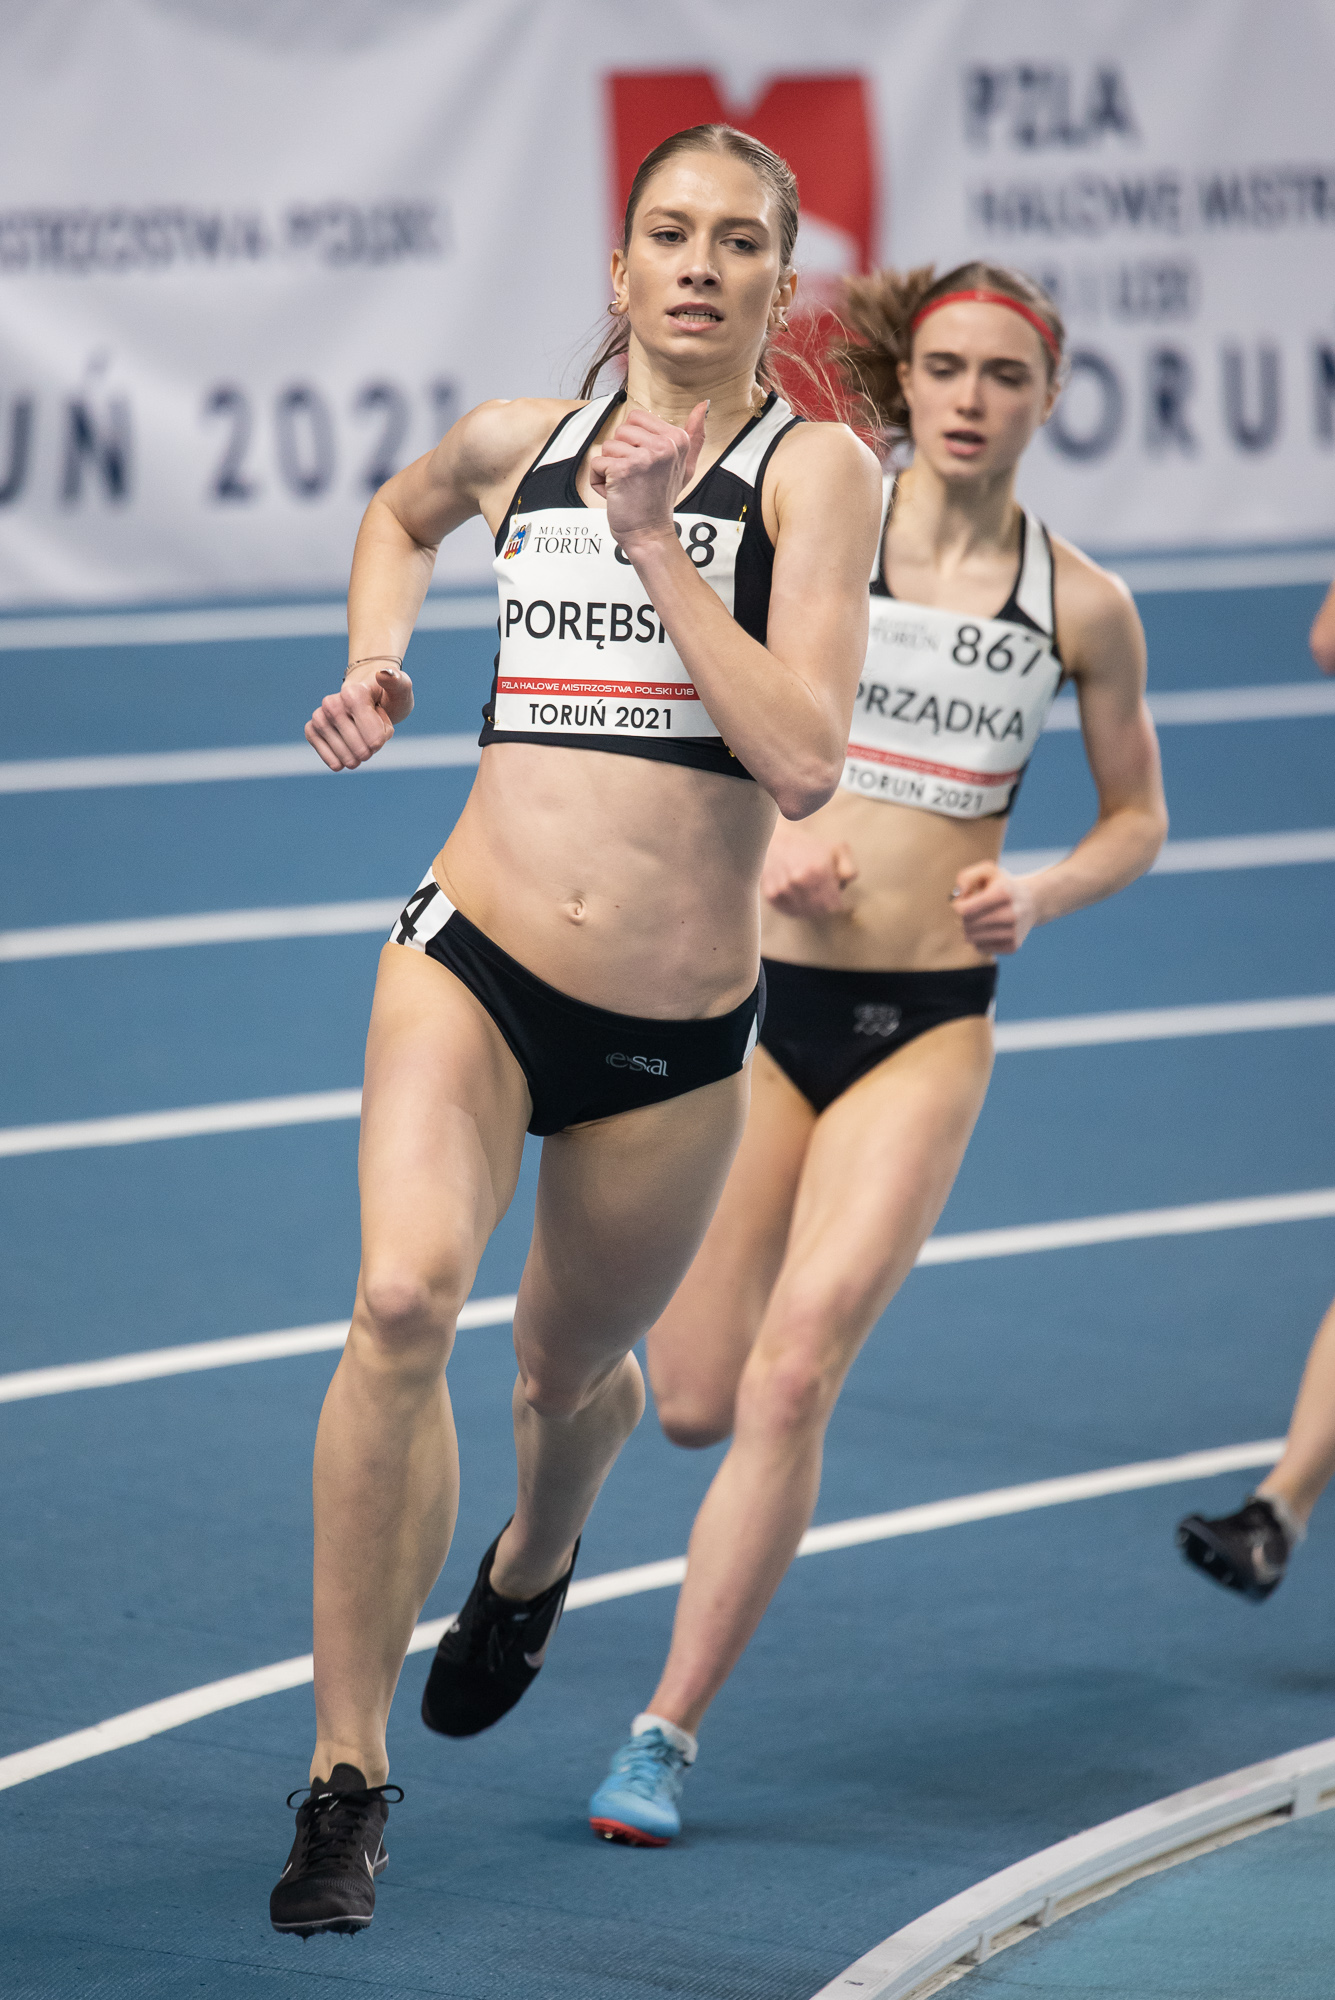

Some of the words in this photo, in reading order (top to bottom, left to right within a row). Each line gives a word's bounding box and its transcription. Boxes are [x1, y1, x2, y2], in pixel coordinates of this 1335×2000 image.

[1046, 339, 1335, 466] ORU
[534, 533, 603, 555] TORUŃ
[538, 526, 589, 536] MIASTO
[501, 681, 519, 690] PZLA
[520, 682, 560, 691] HALOWE
[561, 683, 633, 694] MISTRZOSTWA
[635, 686, 672, 695] POLSKI
[674, 687, 695, 696] U18
[529, 699, 606, 727] TORUŃ
[614, 706, 672, 730] 2021
[931, 784, 984, 810] 2021
[396, 882, 441, 945] 4
